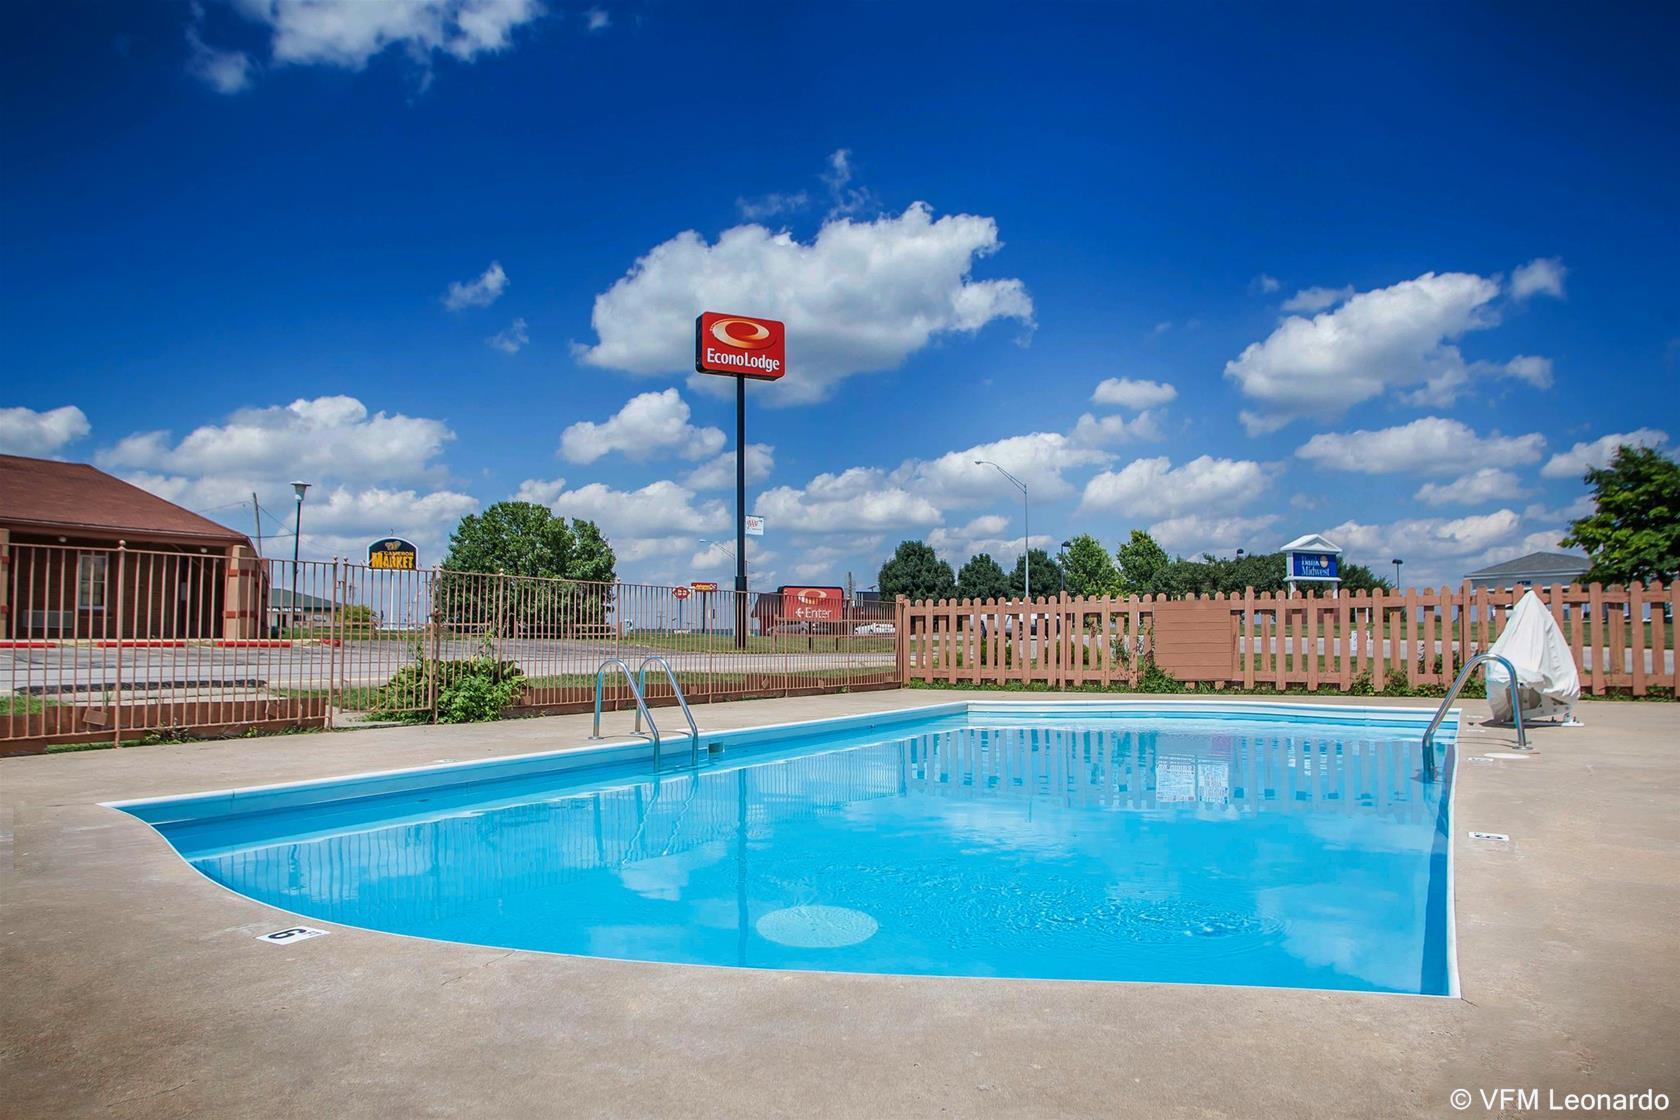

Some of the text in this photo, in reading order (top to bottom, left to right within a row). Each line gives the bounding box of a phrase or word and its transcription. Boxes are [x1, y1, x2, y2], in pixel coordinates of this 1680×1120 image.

[707, 347, 780, 372] EconoLodge
[371, 551, 414, 569] MARKET
[1302, 565, 1330, 577] Midwest
[805, 607, 832, 618] Enter
